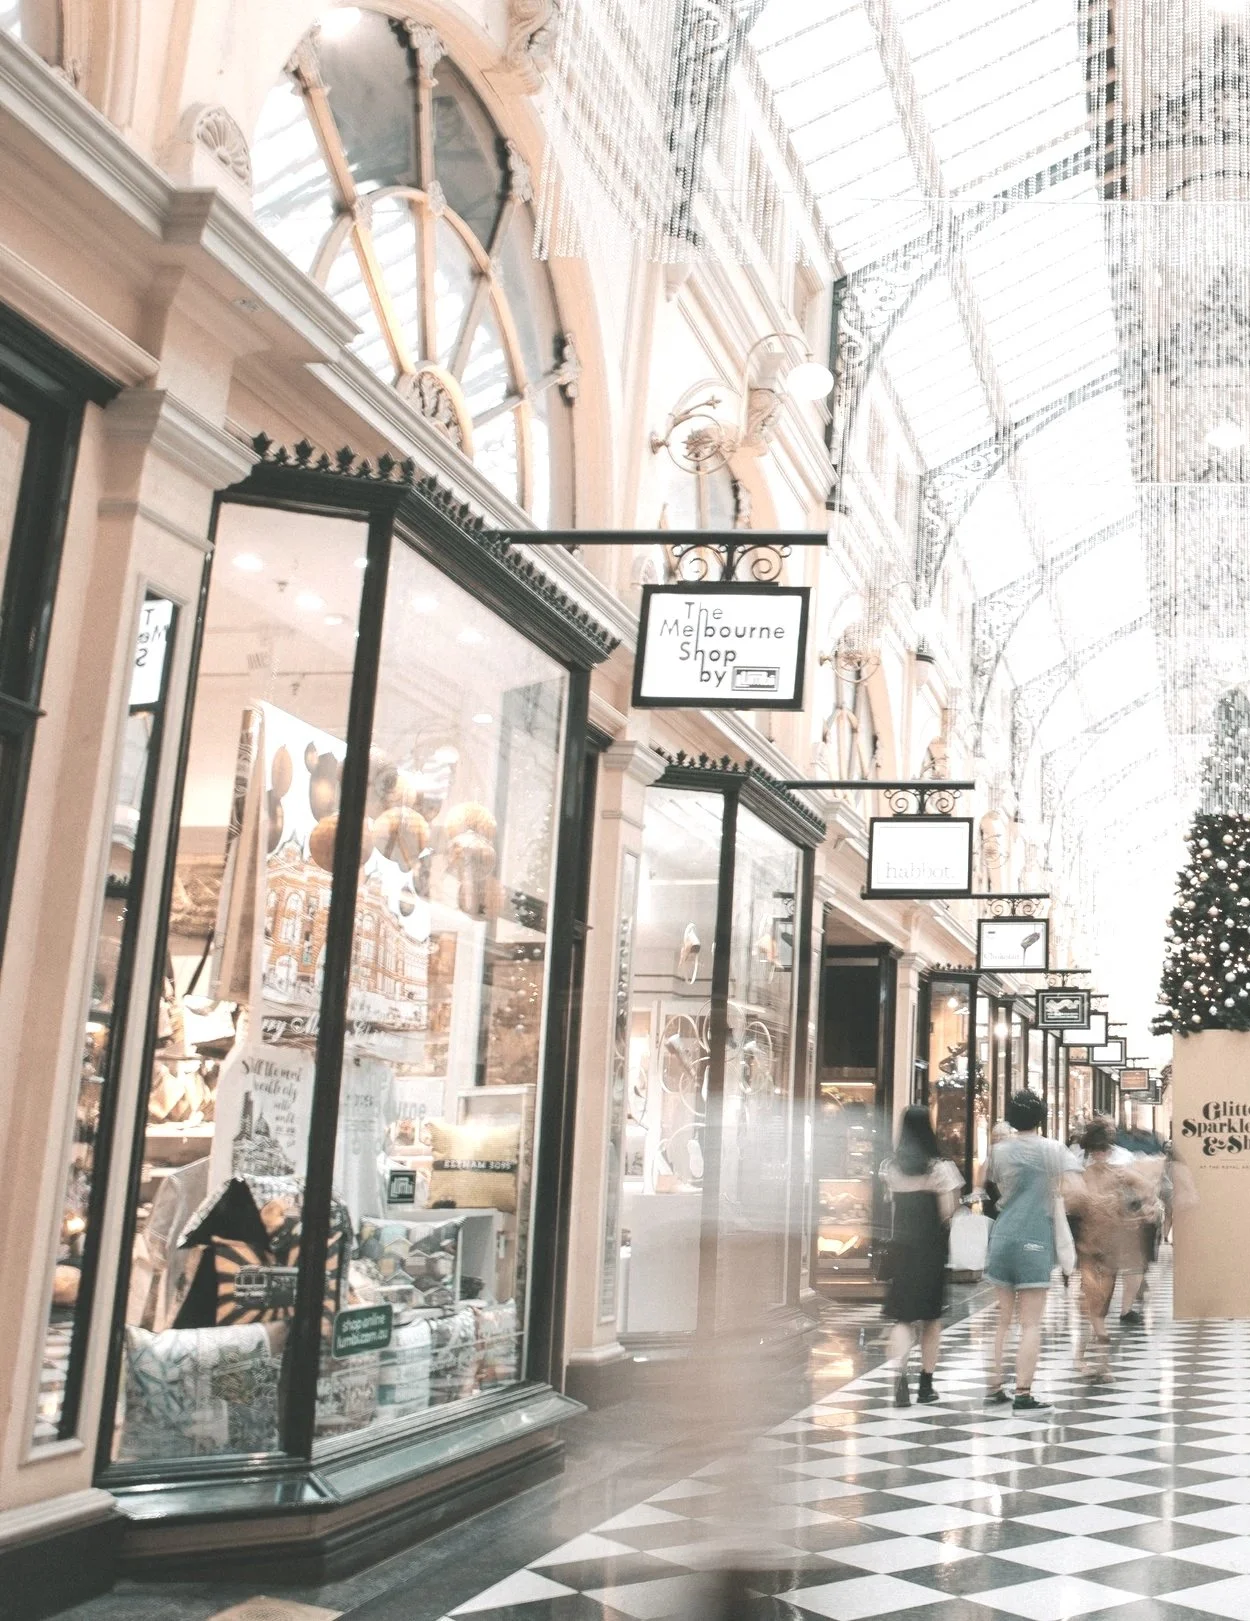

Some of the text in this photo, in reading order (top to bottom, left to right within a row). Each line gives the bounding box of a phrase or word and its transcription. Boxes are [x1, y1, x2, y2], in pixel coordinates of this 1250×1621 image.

[685, 602, 723, 620] The
[660, 618, 785, 639] Melbourne
[679, 641, 737, 667] Shop
[700, 662, 727, 687] by
